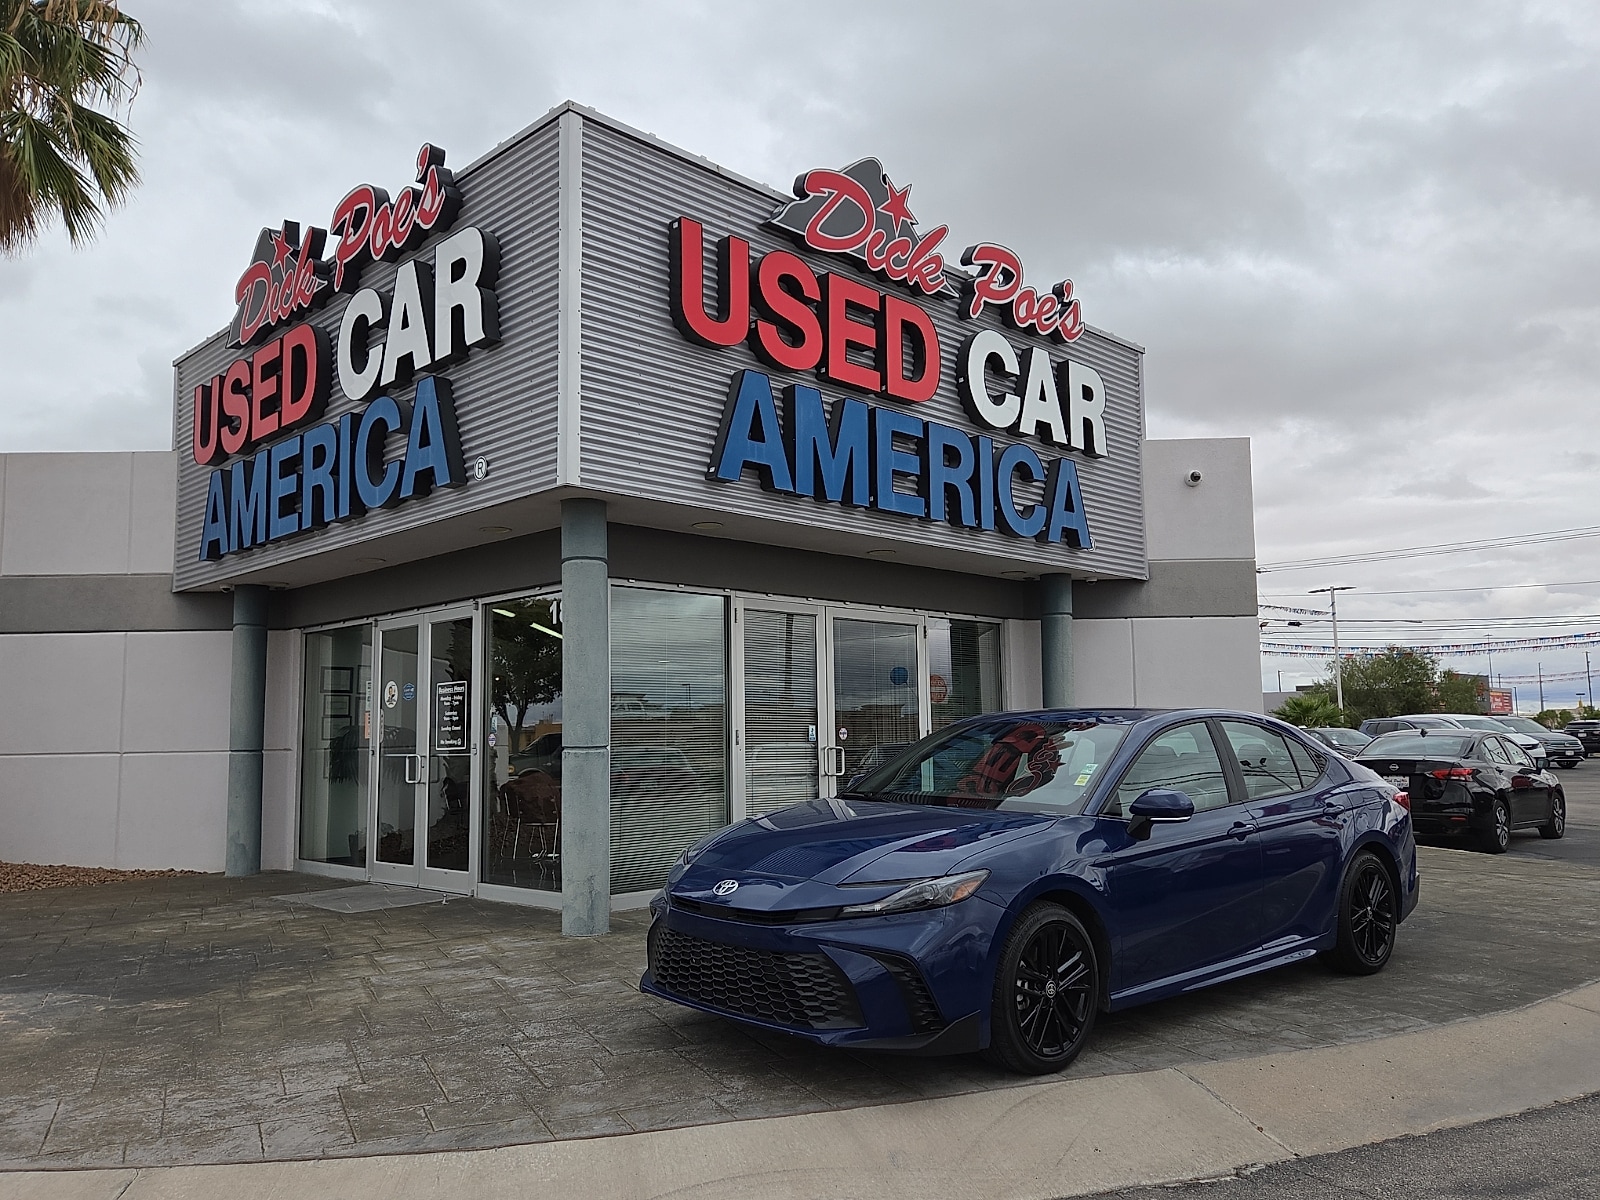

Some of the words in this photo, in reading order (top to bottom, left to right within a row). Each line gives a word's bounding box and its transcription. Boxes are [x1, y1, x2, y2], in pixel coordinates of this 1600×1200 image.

[235, 227, 320, 345] Dick
[331, 143, 450, 291] Poe's
[674, 216, 941, 404] USED
[964, 330, 1107, 458] CAR
[801, 167, 949, 295] Dick
[966, 241, 1085, 343] Poe's
[193, 323, 322, 465] USED
[337, 226, 489, 400] CAR
[199, 376, 456, 561] AMERICA
[712, 369, 1091, 549] AMERICA
